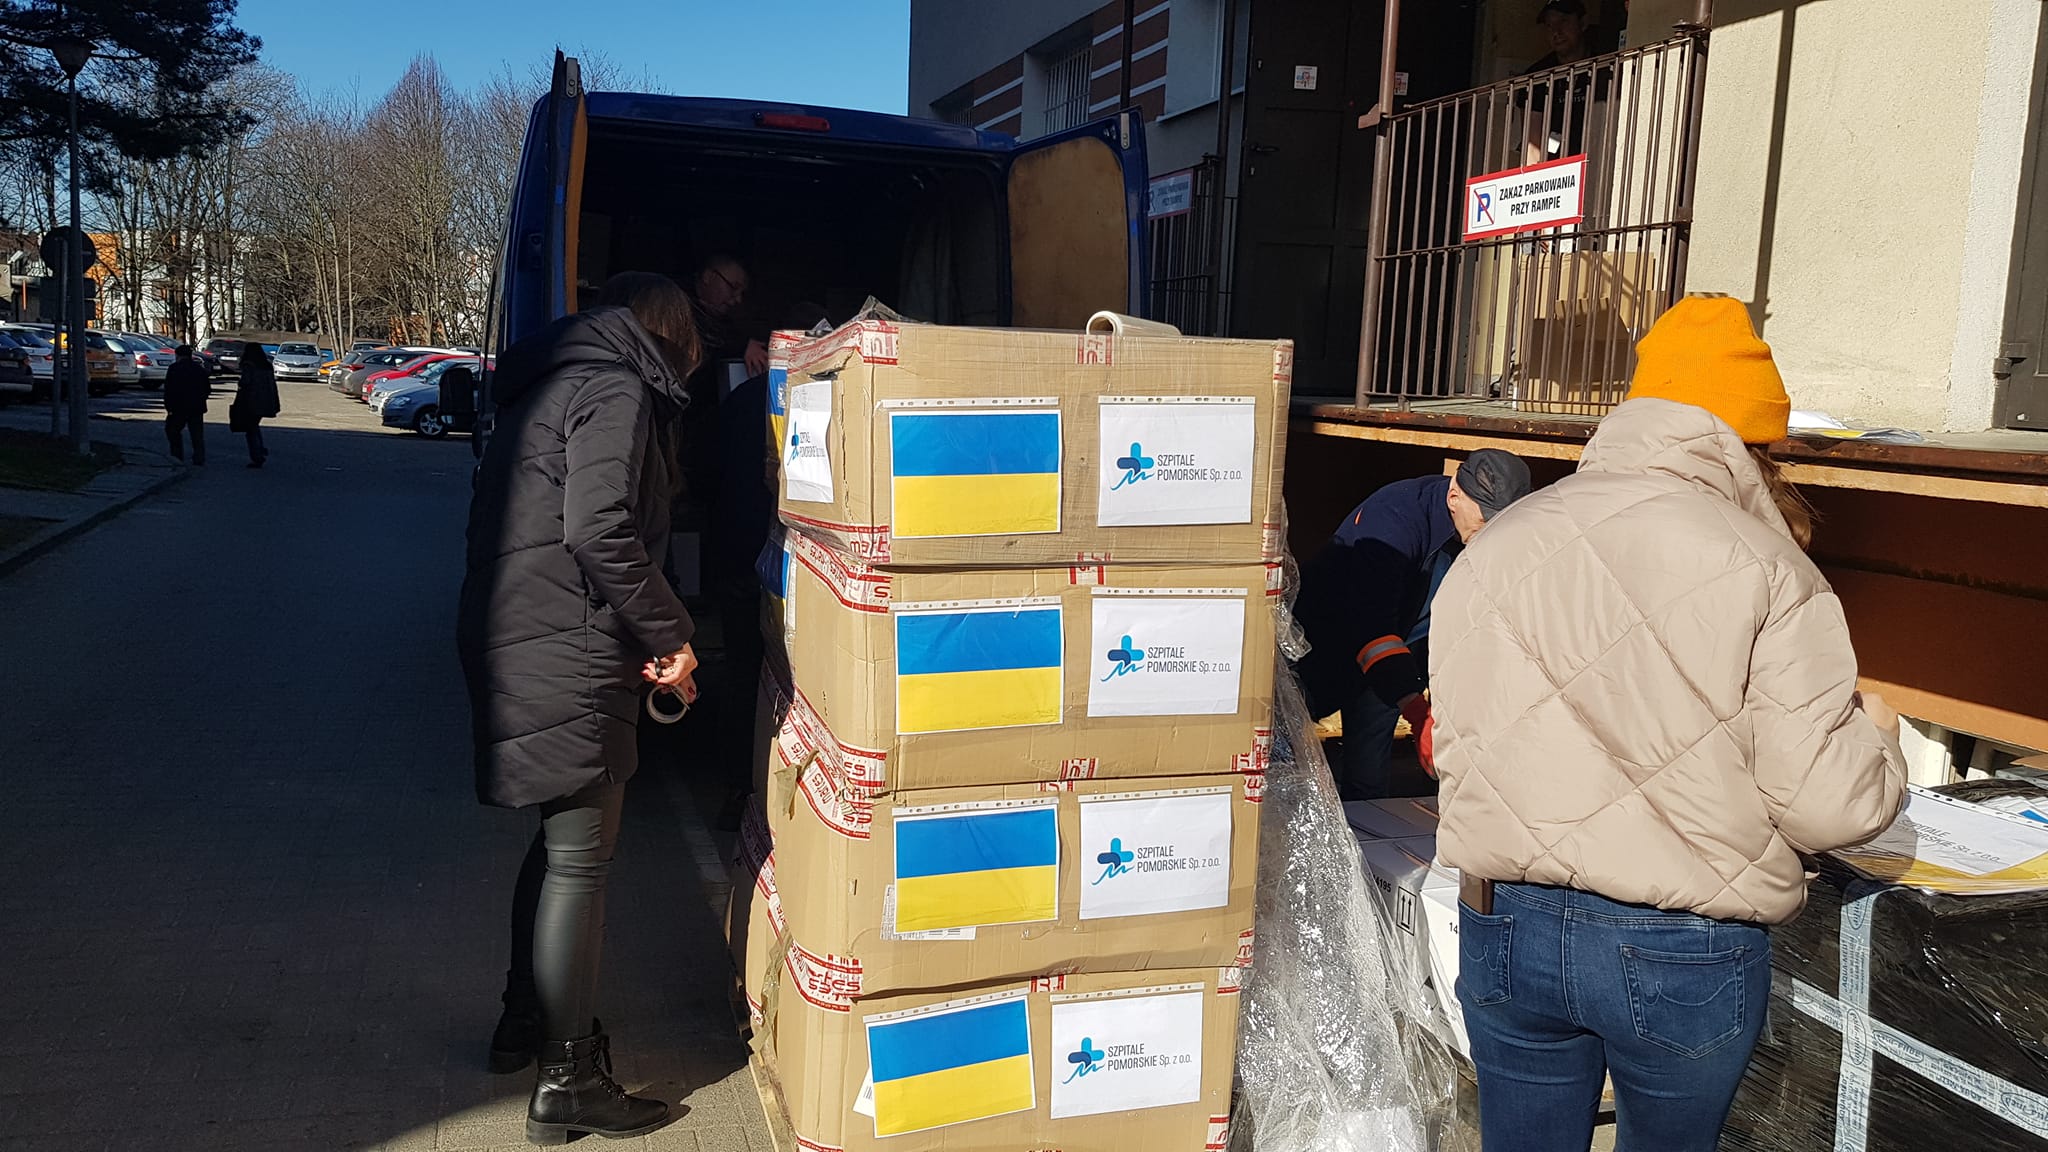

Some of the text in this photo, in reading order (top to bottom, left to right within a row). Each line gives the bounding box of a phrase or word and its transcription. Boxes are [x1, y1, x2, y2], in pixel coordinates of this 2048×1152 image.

[1499, 175, 1576, 201] ZAKAZ PARKOWANIA
[1510, 196, 1561, 216] PRZY RAMPIE
[1157, 454, 1195, 466] SZPITALE
[1157, 469, 1208, 481] POMORSKIE
[1209, 468, 1221, 482] Sp.
[1223, 471, 1228, 480] z
[1147, 647, 1185, 659] SZPITALE
[1147, 661, 1197, 673] POMORSKIE
[1198, 661, 1211, 674] Sp.
[1212, 663, 1217, 672] z
[811, 773, 833, 804] martes
[1137, 845, 1174, 859] SZPITALE
[1137, 858, 1187, 873] POMORSKIE
[1188, 857, 1201, 870] Sp.
[1202, 859, 1207, 868] z
[1107, 1043, 1145, 1058] SZPITALE
[1107, 1056, 1158, 1072] POMORSKIE
[1159, 1054, 1171, 1068] Sp.
[1172, 1056, 1178, 1065] z
